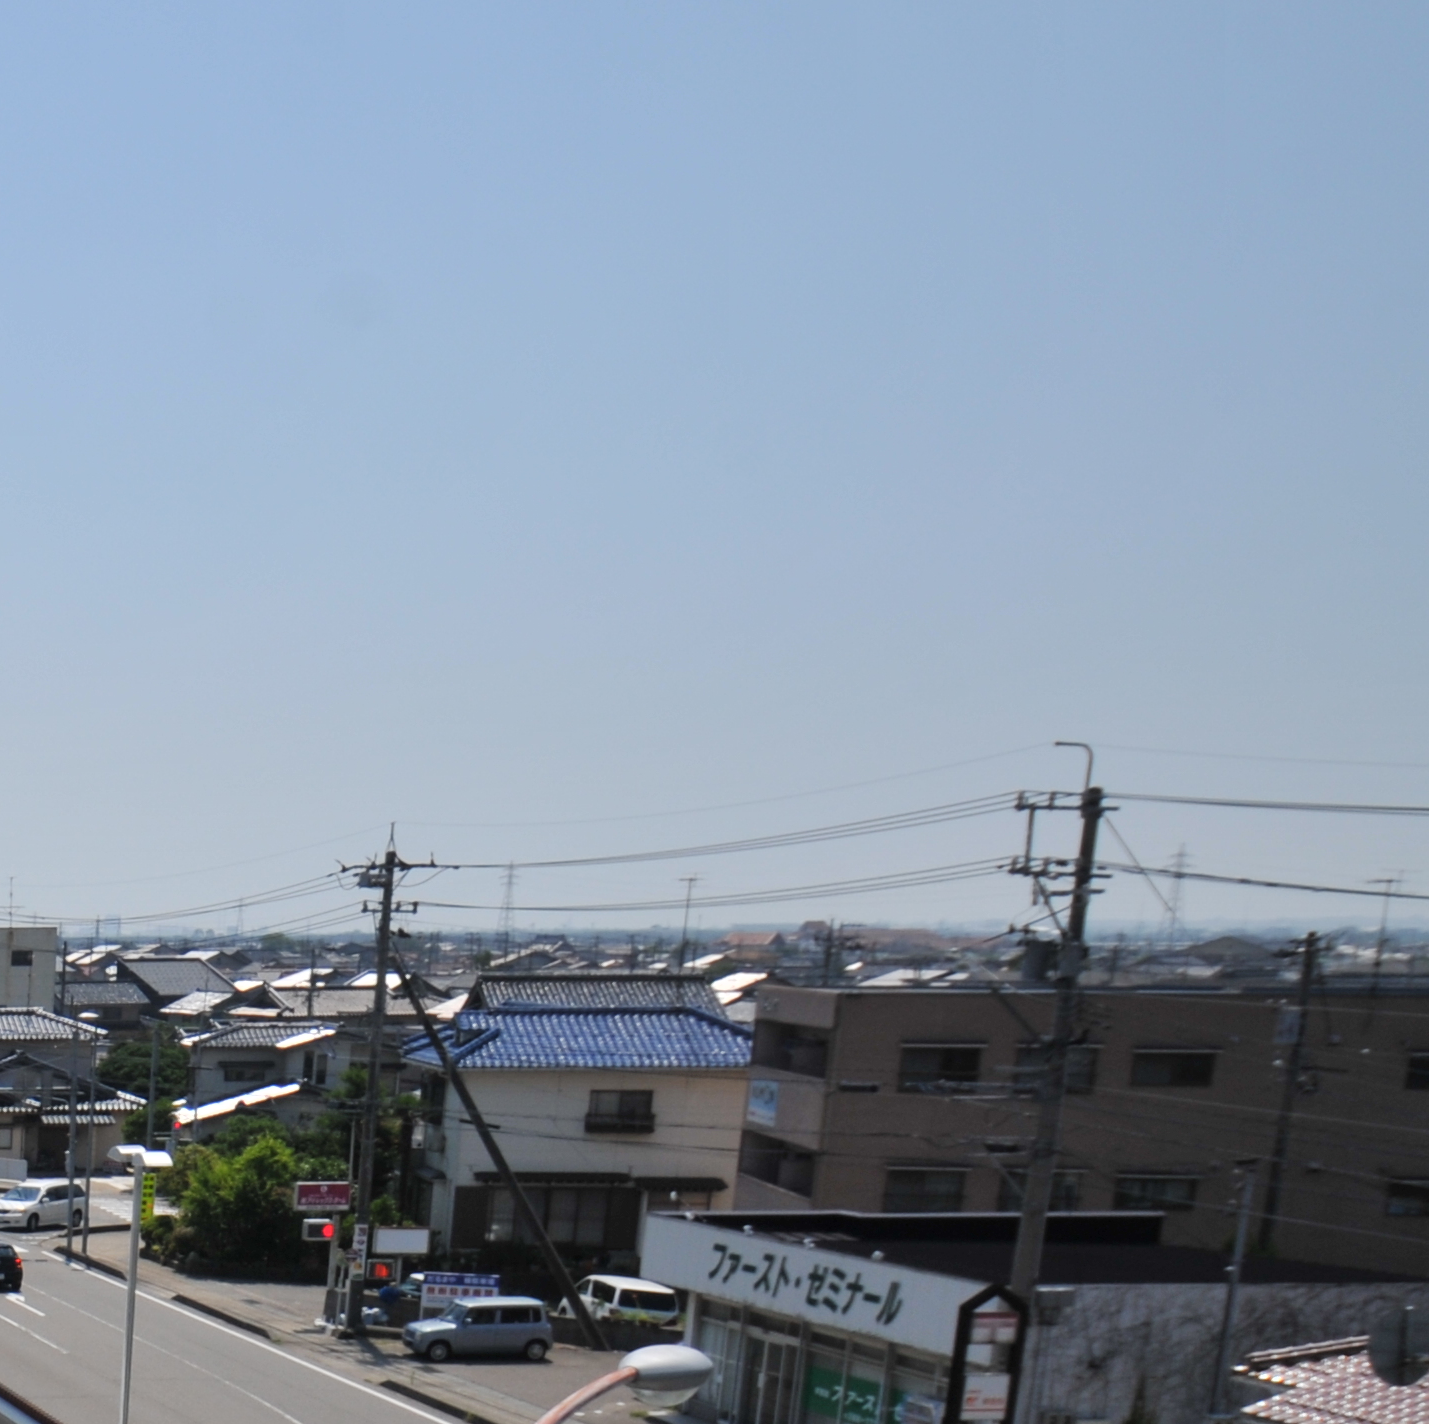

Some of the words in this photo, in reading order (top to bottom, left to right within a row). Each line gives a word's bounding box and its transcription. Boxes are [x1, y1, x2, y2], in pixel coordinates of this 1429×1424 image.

[708, 1243, 903, 1326] ファースト・ゼミナール
